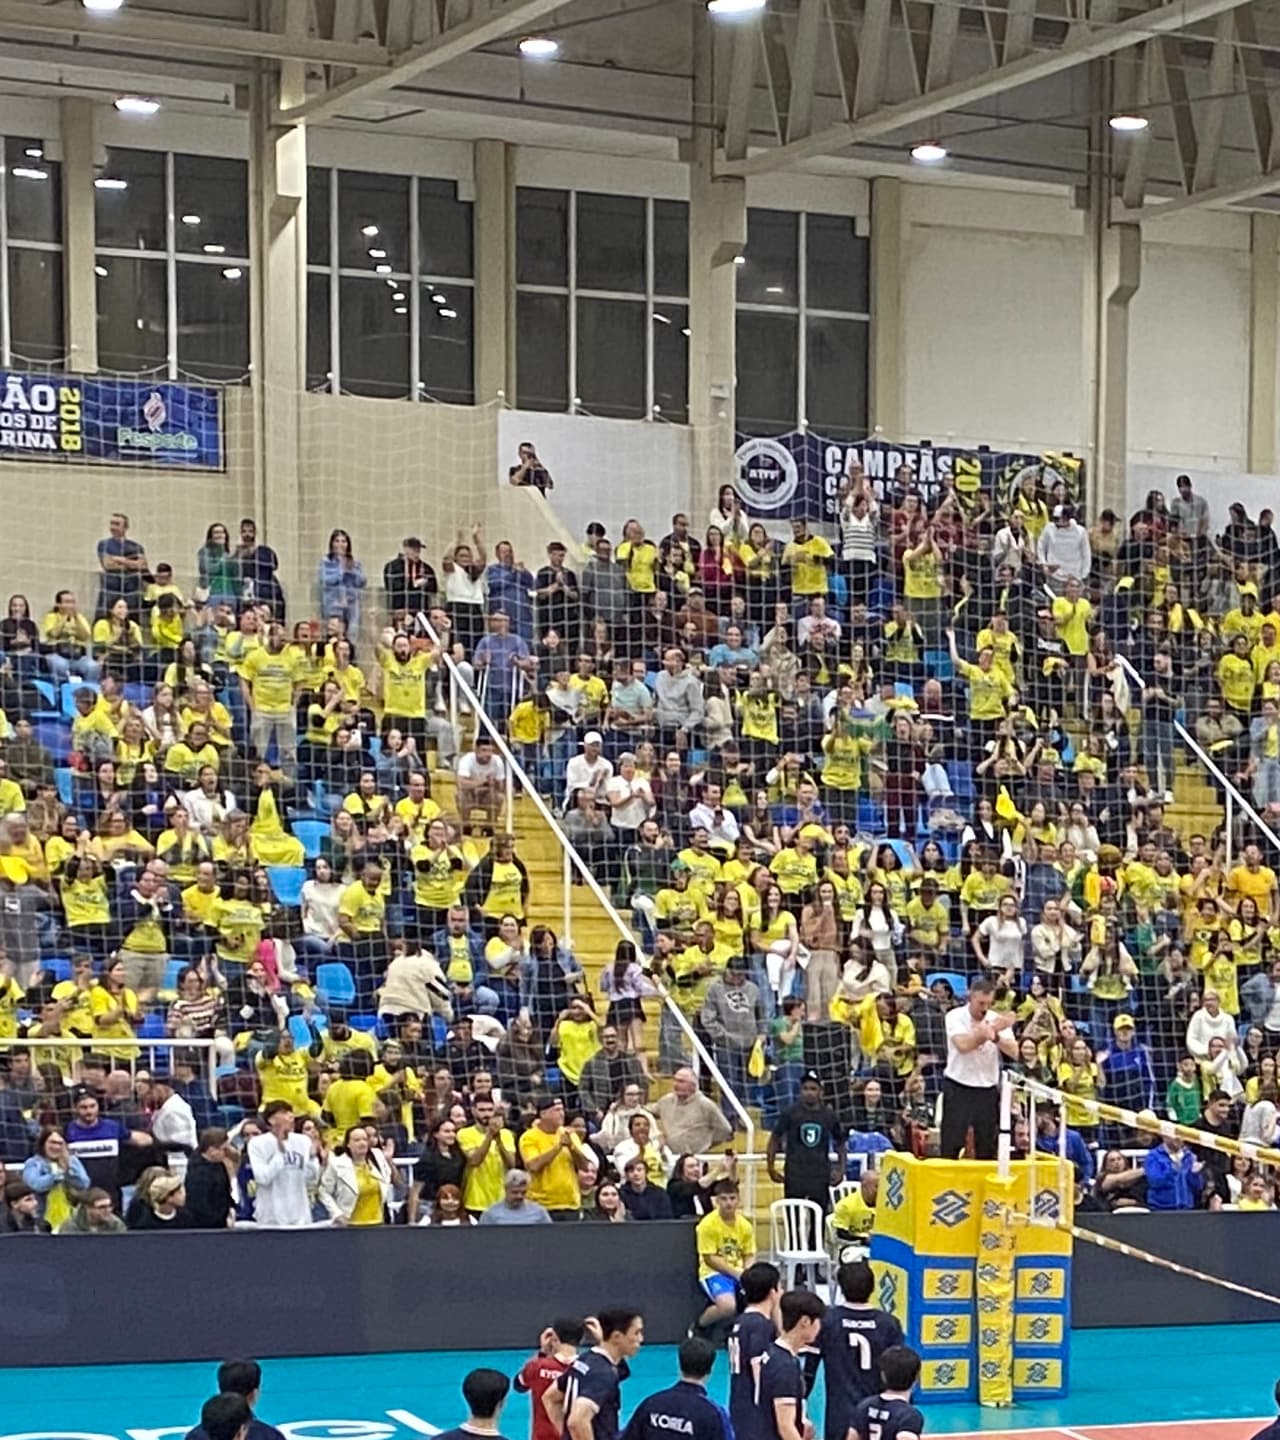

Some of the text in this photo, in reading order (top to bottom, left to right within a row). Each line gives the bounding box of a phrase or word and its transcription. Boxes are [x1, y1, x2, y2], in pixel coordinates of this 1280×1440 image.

[31, 416, 57, 431] DE
[60, 387, 81, 450] 2018
[650, 1413, 693, 1436] KOREA
